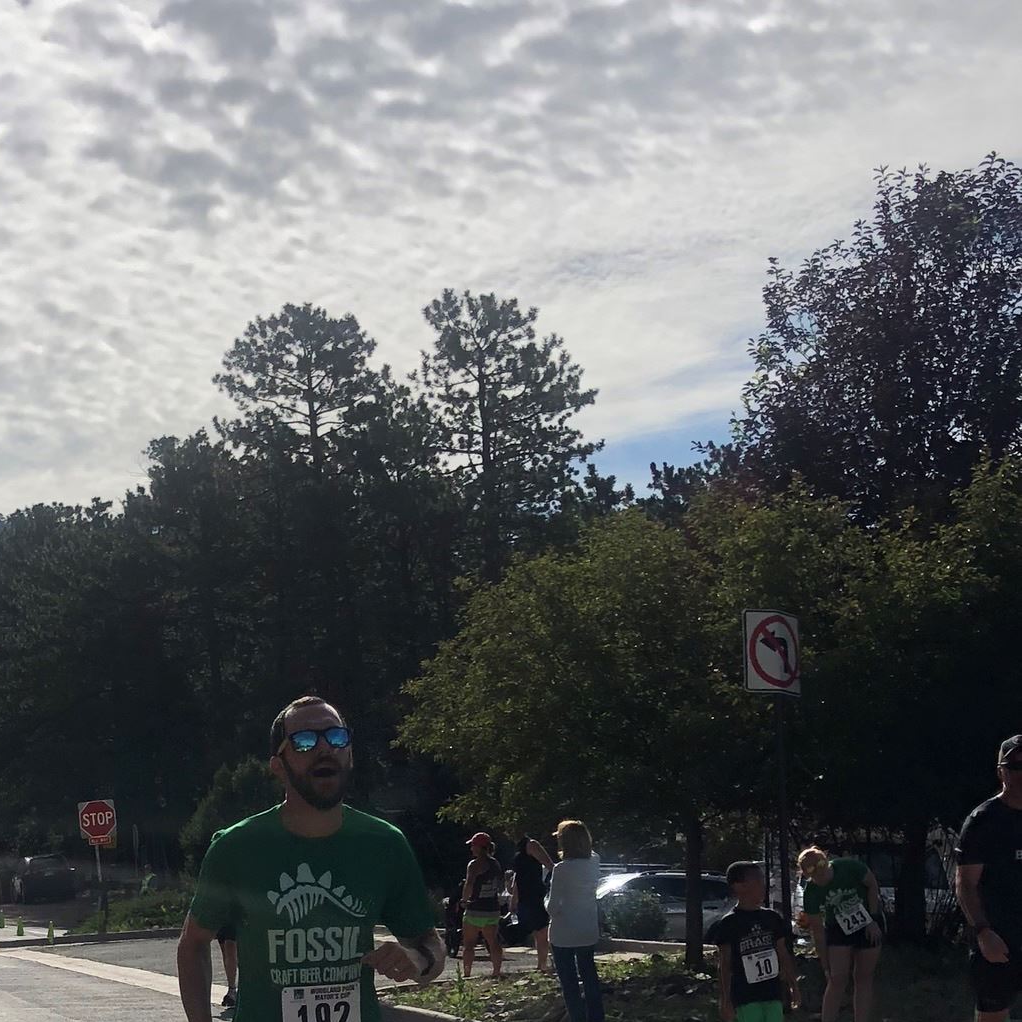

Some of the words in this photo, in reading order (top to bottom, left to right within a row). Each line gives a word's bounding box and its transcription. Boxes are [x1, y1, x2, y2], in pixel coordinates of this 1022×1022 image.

[82, 811, 113, 827] STOP
[843, 911, 866, 930] 243
[268, 927, 364, 964] FOSSIL
[270, 968, 298, 985] CRAFT
[300, 966, 321, 984] BEER
[323, 962, 363, 982] COMPANY
[755, 958, 772, 977] 10
